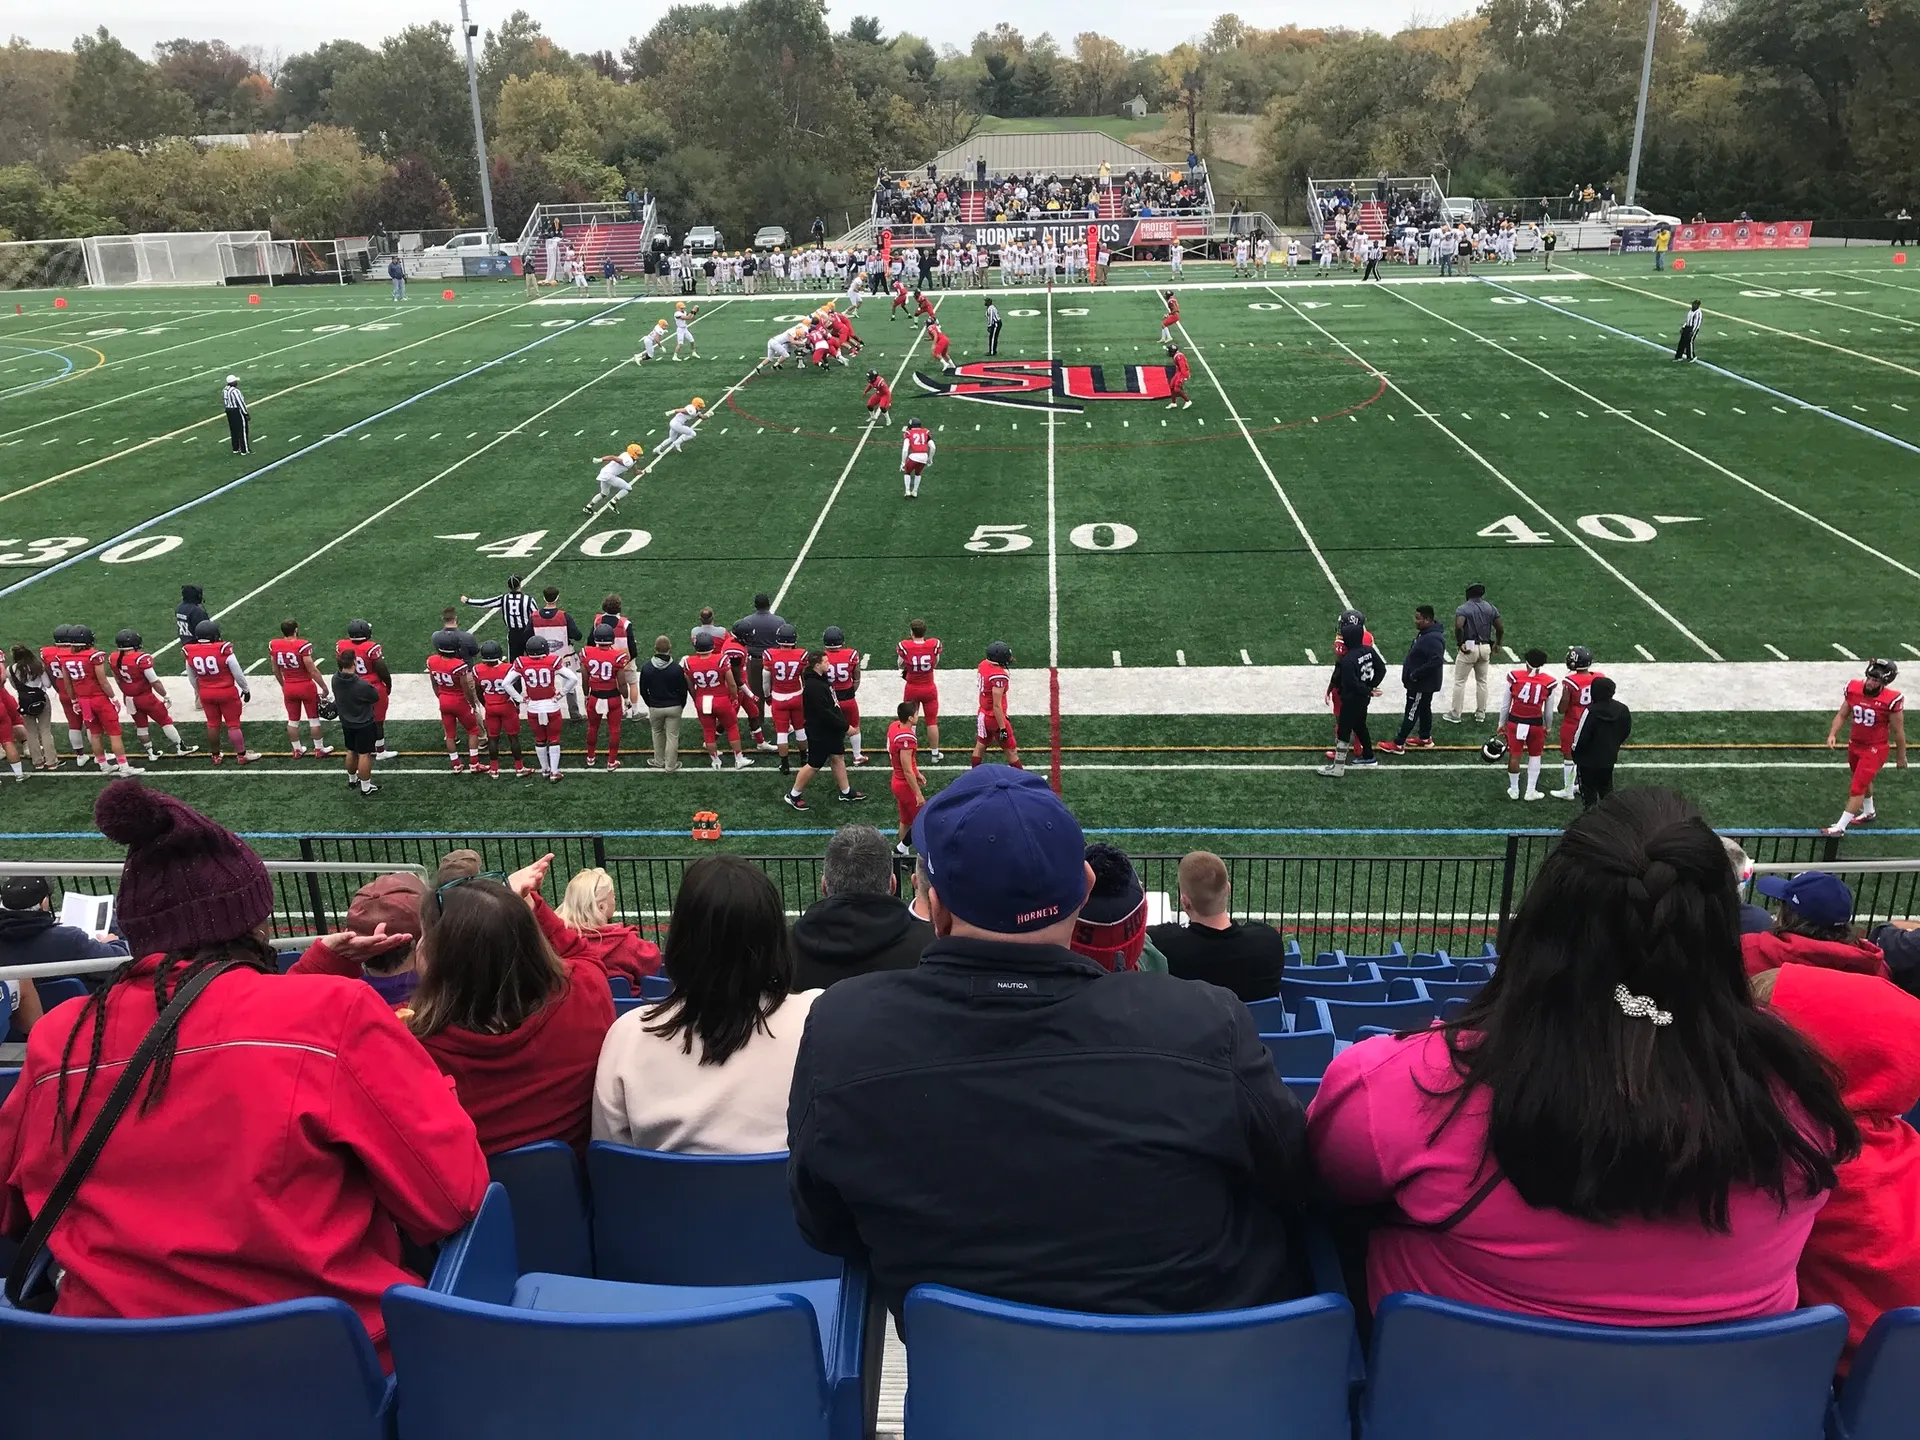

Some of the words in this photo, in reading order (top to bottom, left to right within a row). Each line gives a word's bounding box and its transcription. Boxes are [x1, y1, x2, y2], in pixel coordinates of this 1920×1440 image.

[976, 226, 1036, 246] HORNET
[1041, 224, 1120, 243] ATHLEICS
[1141, 222, 1172, 231] PROTECT
[935, 360, 1176, 403] SU
[913, 433, 926, 445] 21
[964, 522, 1139, 553] 50
[1477, 513, 1657, 543] 40
[0, 535, 184, 564] 30
[476, 529, 652, 557] 40
[509, 600, 520, 616] H
[65, 661, 86, 680] 51
[192, 656, 220, 676] 99
[276, 652, 300, 669] 43
[588, 659, 613, 681] 20
[120, 665, 133, 684] 5
[524, 668, 552, 688] 30
[693, 670, 721, 688] 32
[774, 661, 801, 682] 37
[1517, 682, 1542, 705] 41
[1016, 905, 1060, 926] HORNETS
[997, 981, 1029, 990] NAUTICA
